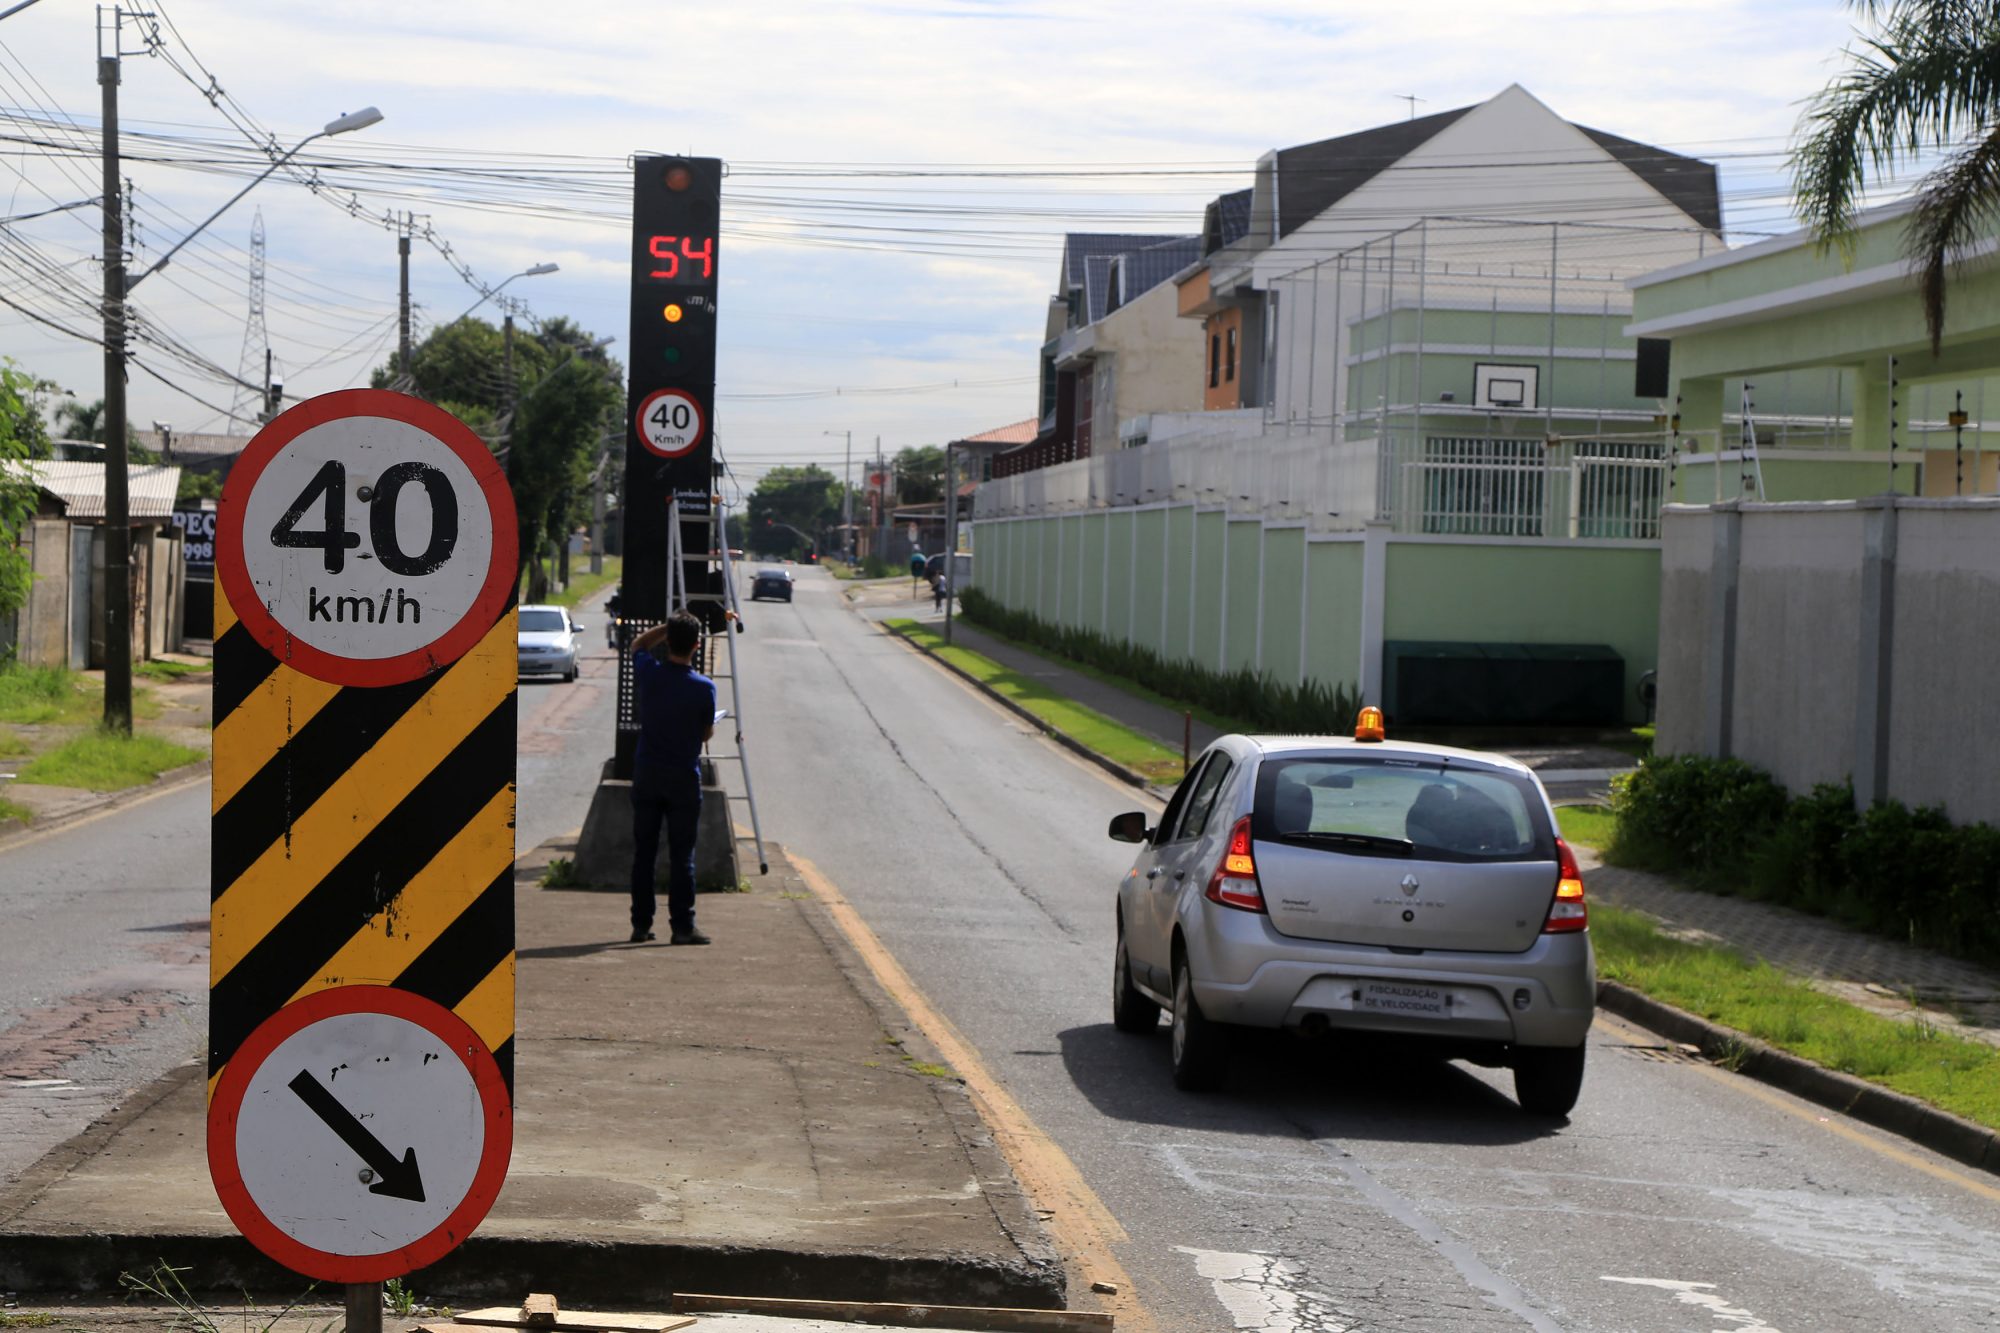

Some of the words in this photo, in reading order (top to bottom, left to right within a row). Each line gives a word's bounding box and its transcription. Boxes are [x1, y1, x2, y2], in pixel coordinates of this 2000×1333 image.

[649, 235, 712, 278] 54
[650, 403, 690, 430] 40
[654, 434, 685, 444] Km/h
[270, 460, 458, 577] 40
[309, 586, 420, 624] km/h
[1365, 998, 1377, 1008] DE
[1380, 1000, 1441, 1013] VELOCIDADE
[1369, 984, 1439, 1000] FISCALIZAÇÃO
